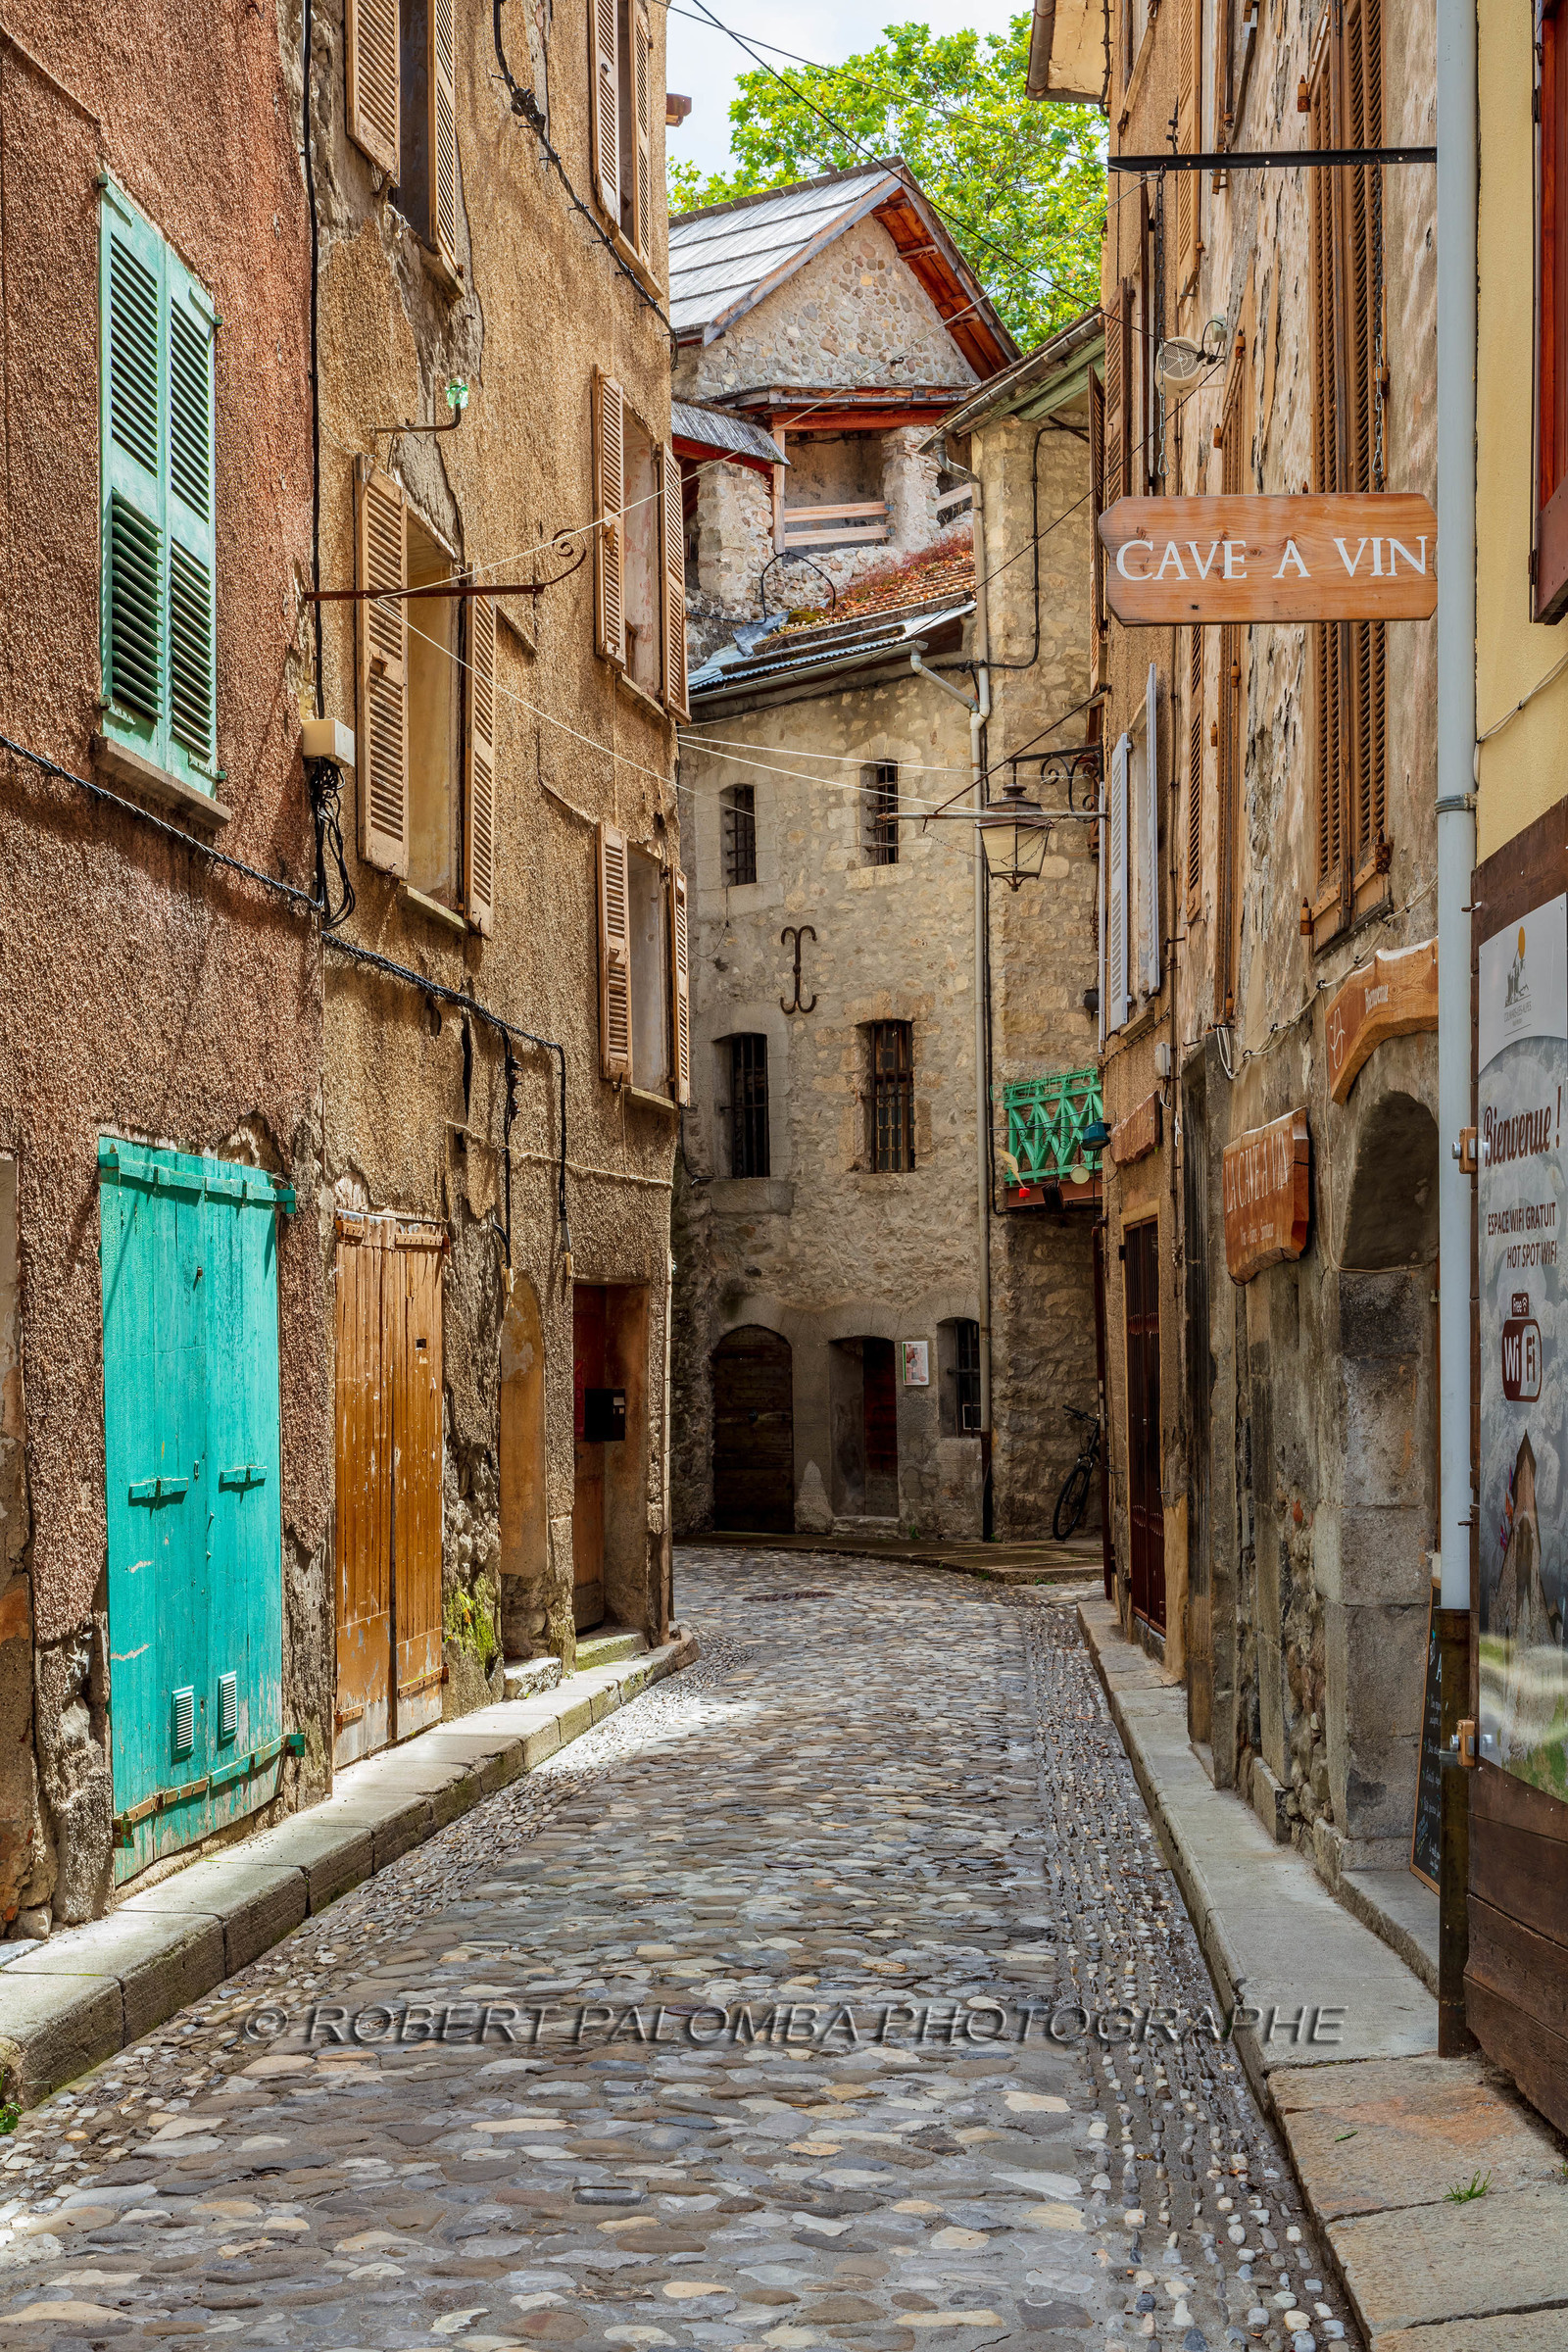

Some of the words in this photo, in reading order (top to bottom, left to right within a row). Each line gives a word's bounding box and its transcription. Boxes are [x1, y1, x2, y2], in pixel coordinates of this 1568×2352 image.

[1115, 539, 1249, 581] CAVE
[1271, 539, 1311, 579] A
[1332, 535, 1429, 578] VIN
[1483, 1105, 1552, 1168] Bienvenue
[1225, 1157, 1238, 1214] LA
[1238, 1143, 1261, 1208] CAVE
[1261, 1139, 1269, 1199] A
[1271, 1126, 1290, 1192] VIN
[1488, 1208, 1510, 1237] ESPACE
[1509, 1205, 1525, 1234] WIFI
[1525, 1200, 1557, 1232] GRATUIT
[1506, 1244, 1521, 1270] HOT
[1521, 1242, 1541, 1268] SPOT
[1541, 1240, 1558, 1266] WIFI
[1512, 1297, 1522, 1313] Free
